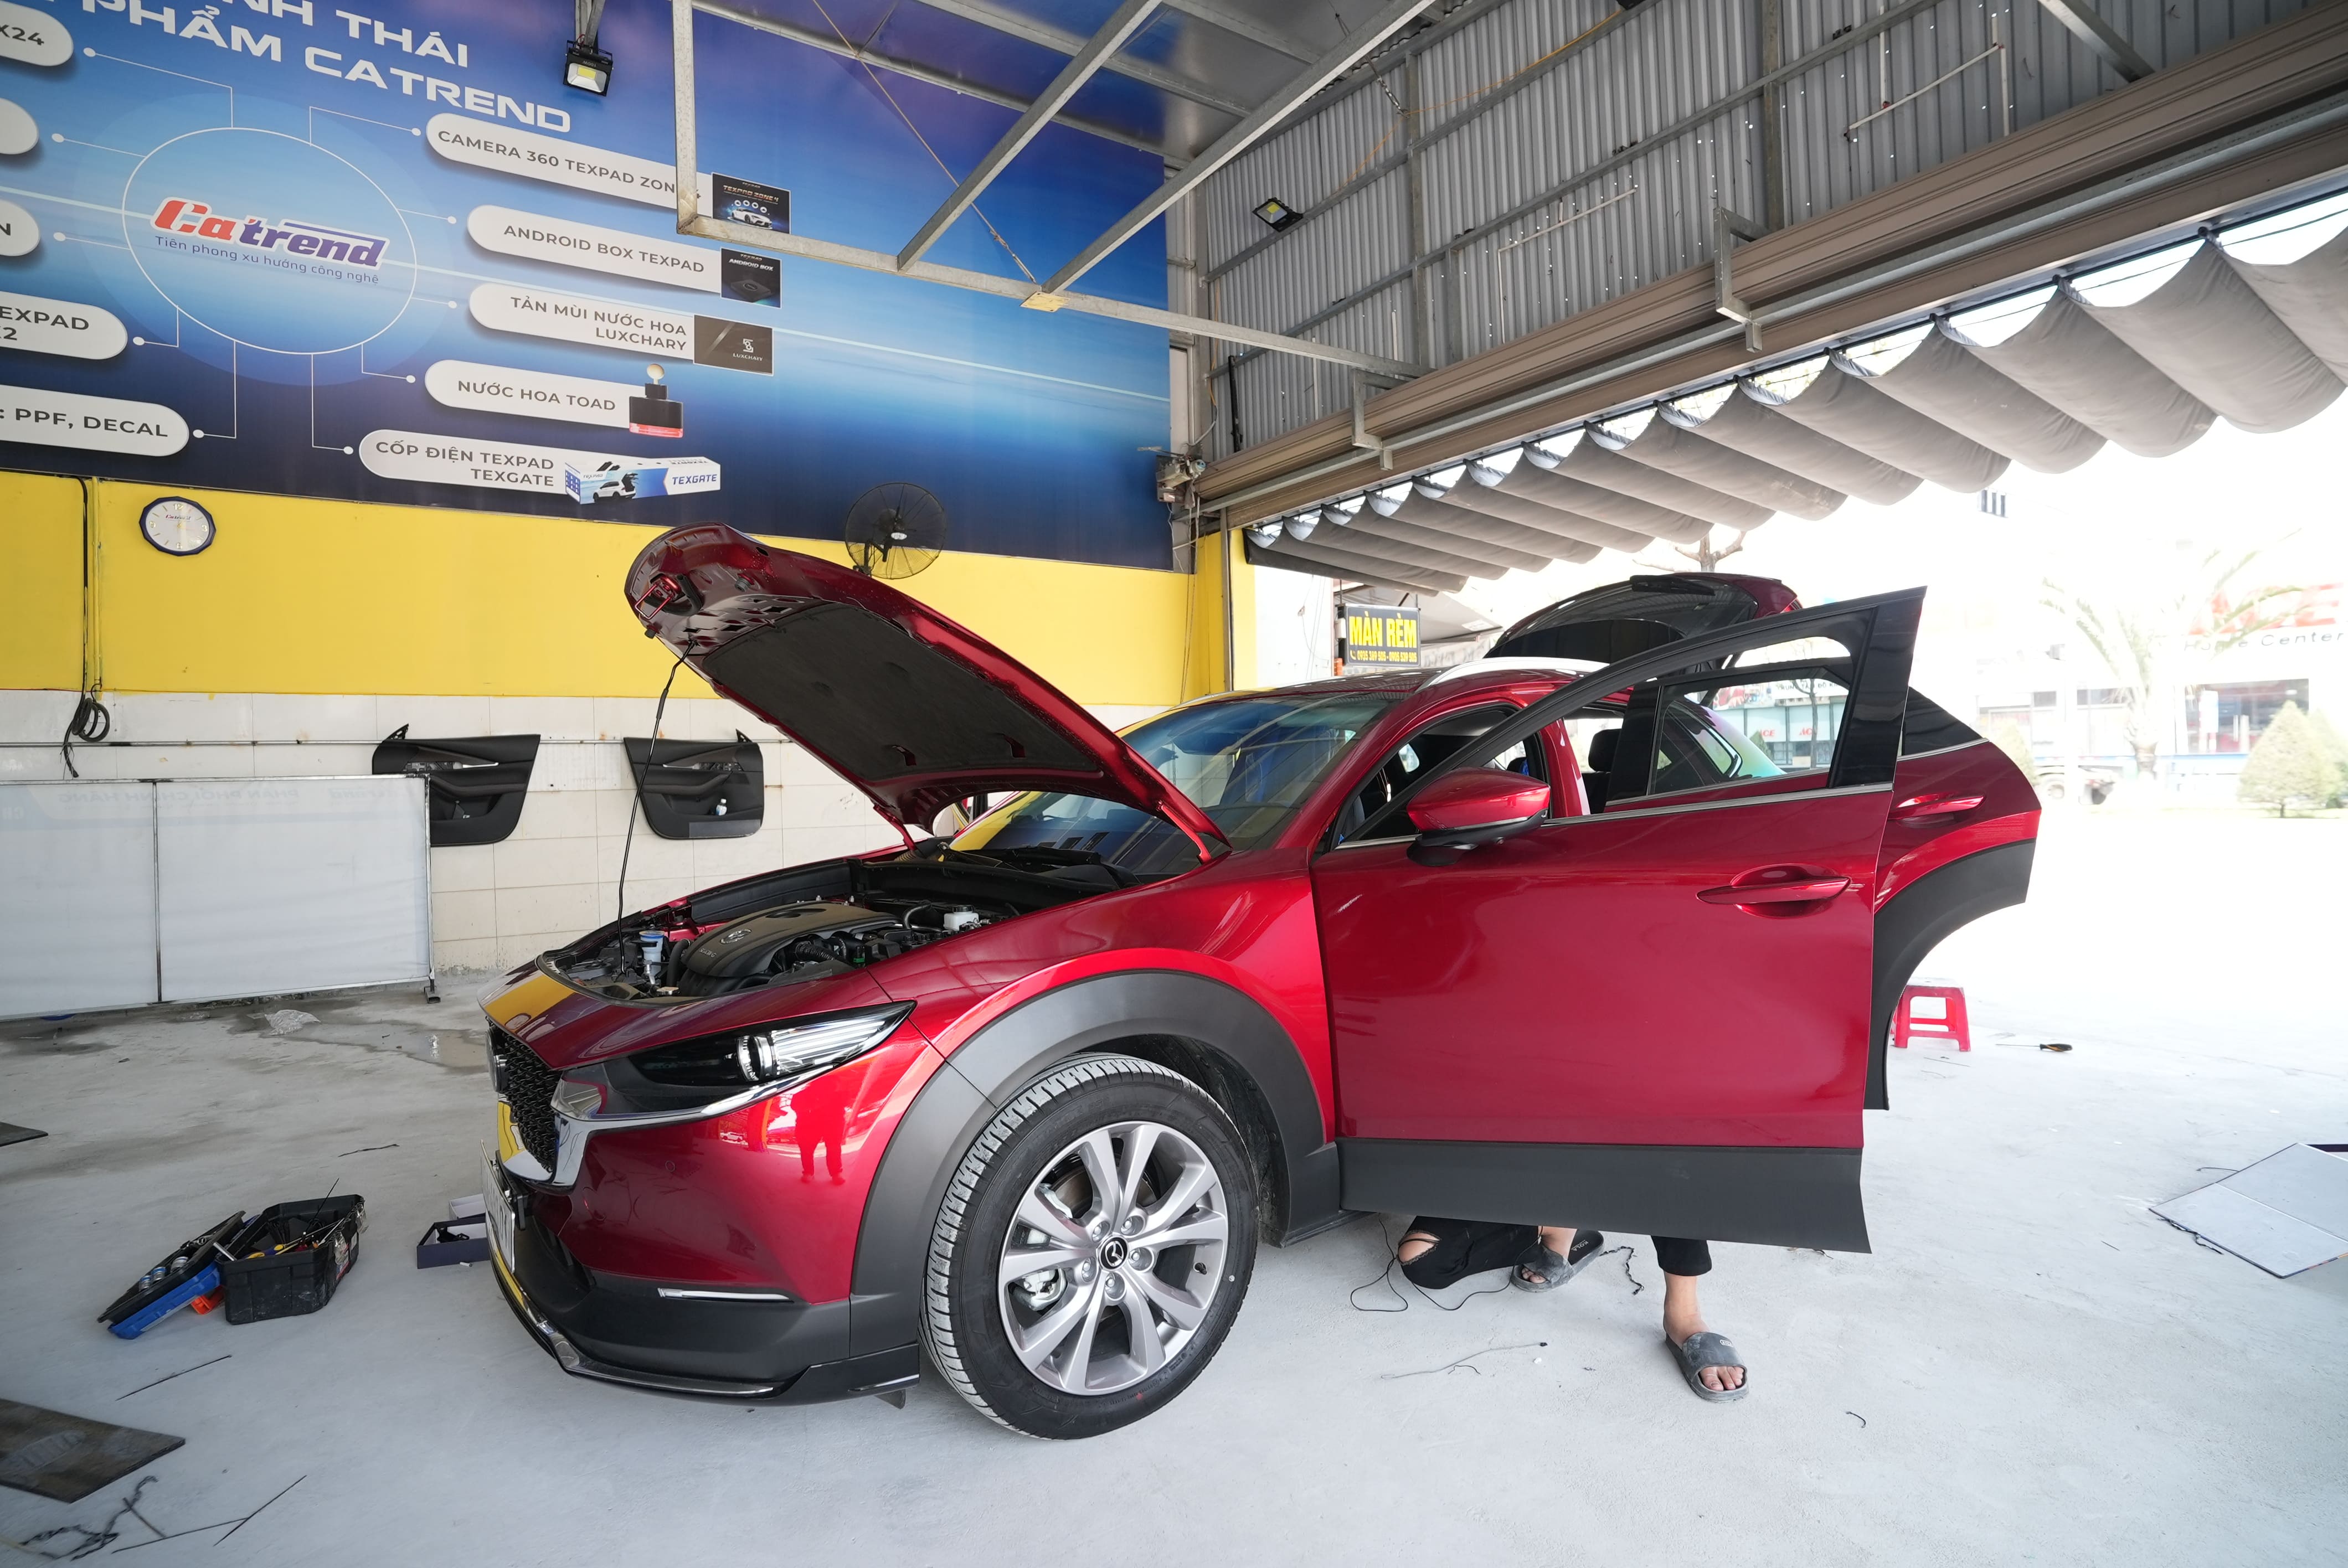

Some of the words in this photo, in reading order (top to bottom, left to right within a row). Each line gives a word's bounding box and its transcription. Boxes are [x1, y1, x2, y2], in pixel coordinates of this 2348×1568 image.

[336, 9, 468, 68] THÁI
[83, 0, 282, 62] PHẨM
[305, 47, 570, 133] CATREND
[438, 131, 521, 159] CAMERA
[527, 151, 559, 167] 360
[564, 159, 635, 184] TEXPAD
[640, 177, 675, 193] ZON
[155, 200, 386, 267] Catrend
[504, 225, 591, 251] ANDROID
[597, 243, 634, 259] BOX
[639, 251, 704, 272] TEXPAD
[155, 235, 187, 250] Tiên
[192, 244, 238, 261] phong
[242, 254, 259, 264] xu
[264, 255, 306, 273] hướng
[311, 265, 343, 280] công
[347, 270, 380, 286] nghệ
[729, 259, 759, 269] ANDROID
[511, 295, 547, 312] TẢN
[554, 301, 588, 319] MÙI
[594, 309, 645, 329] NƯỚC
[650, 320, 687, 336] HOA
[595, 327, 686, 352] LUXCHARY
[457, 380, 514, 398] NƯỚC
[520, 388, 561, 404] HOA
[565, 394, 616, 411] TOAD
[16, 408, 74, 429] PPF,
[84, 416, 168, 437] DECAL
[375, 439, 419, 456] CỐP
[425, 446, 473, 464] ĐIỆN
[480, 452, 554, 470] TEXPAD
[470, 468, 554, 487] TEXGATE
[672, 473, 718, 486] TEXGATE
[1348, 610, 1383, 647] MÀN
[1386, 612, 1417, 648] RÈM
[2261, 632, 2344, 646] Center
[1572, 1241, 1589, 1251] KOLA
